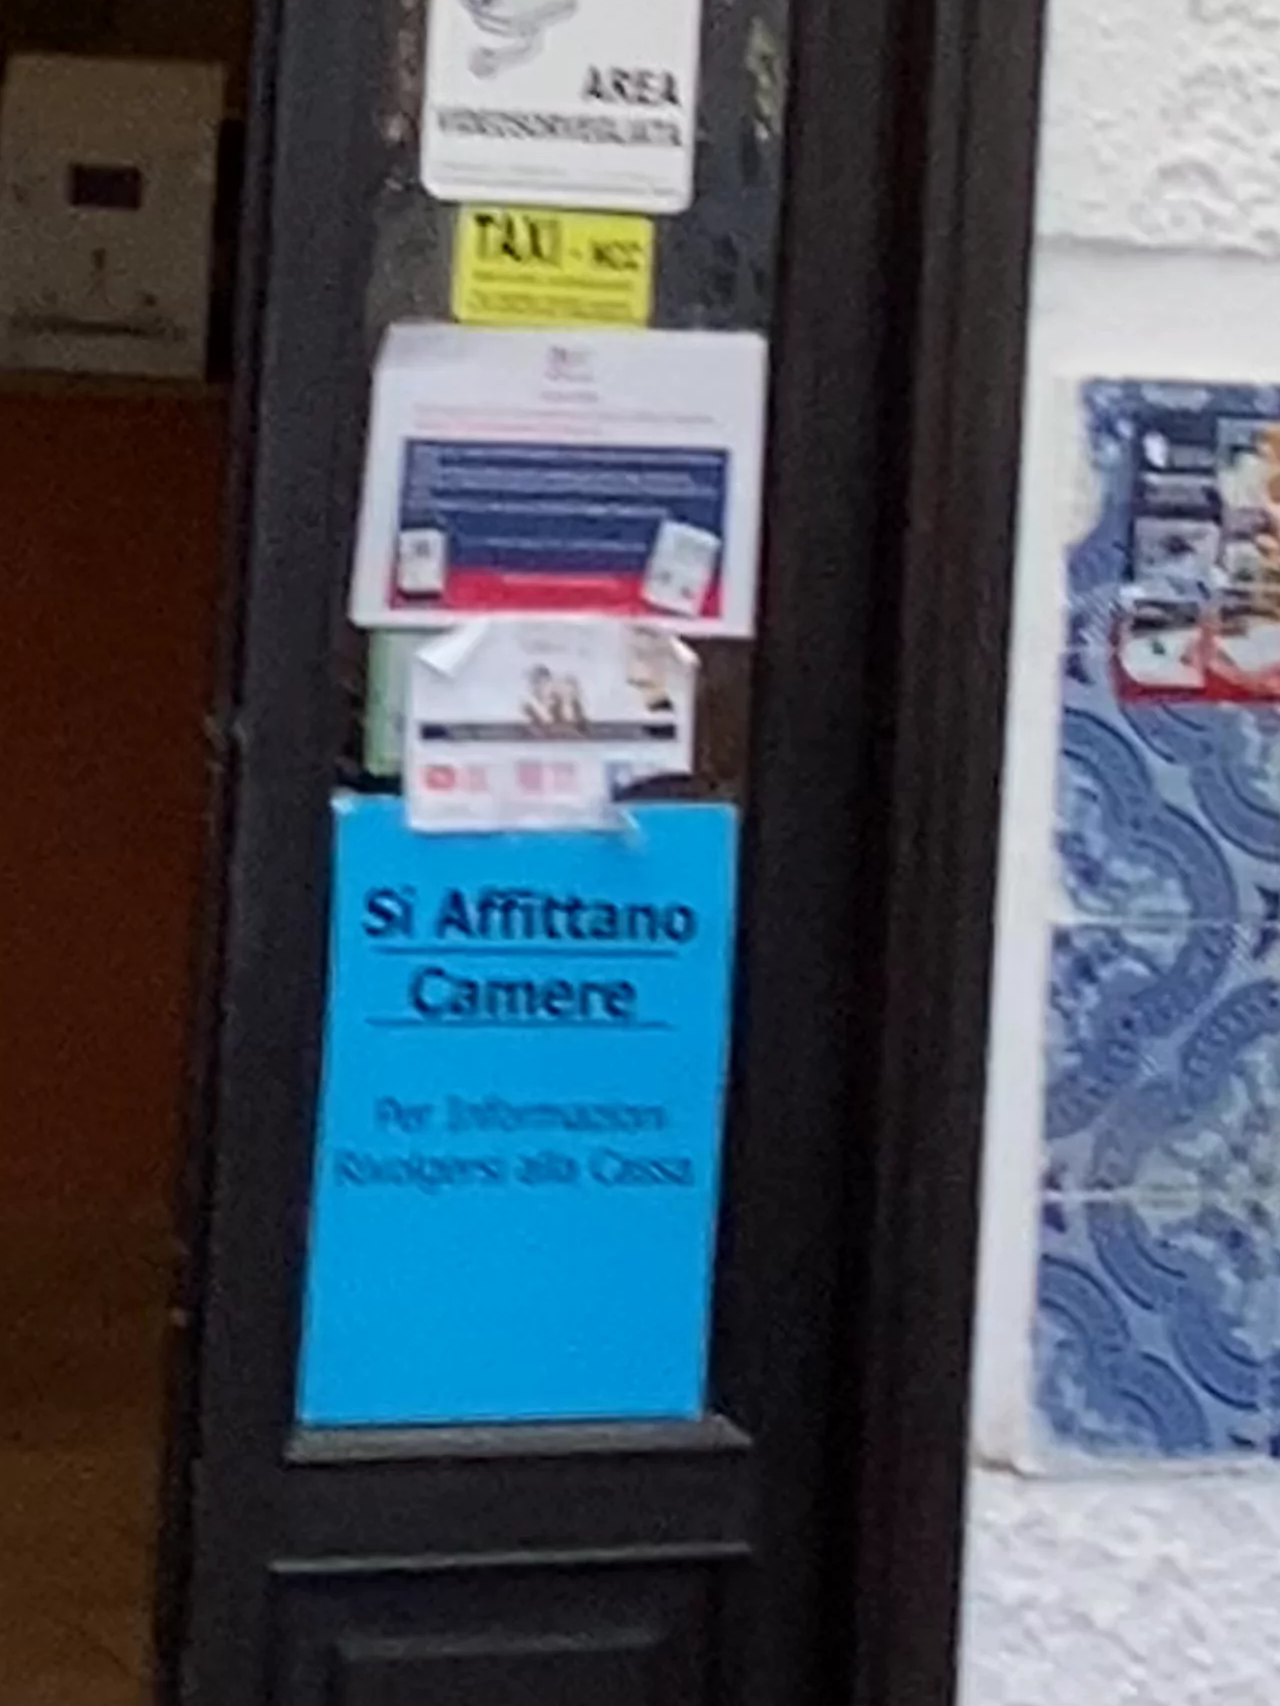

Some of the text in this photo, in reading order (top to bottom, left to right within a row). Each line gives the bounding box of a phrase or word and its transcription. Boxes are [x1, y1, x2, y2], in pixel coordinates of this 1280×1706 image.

[582, 64, 680, 108] AREA
[474, 212, 563, 270] TAXI
[362, 884, 699, 945] Si Affittano
[410, 966, 640, 1019] Camere
